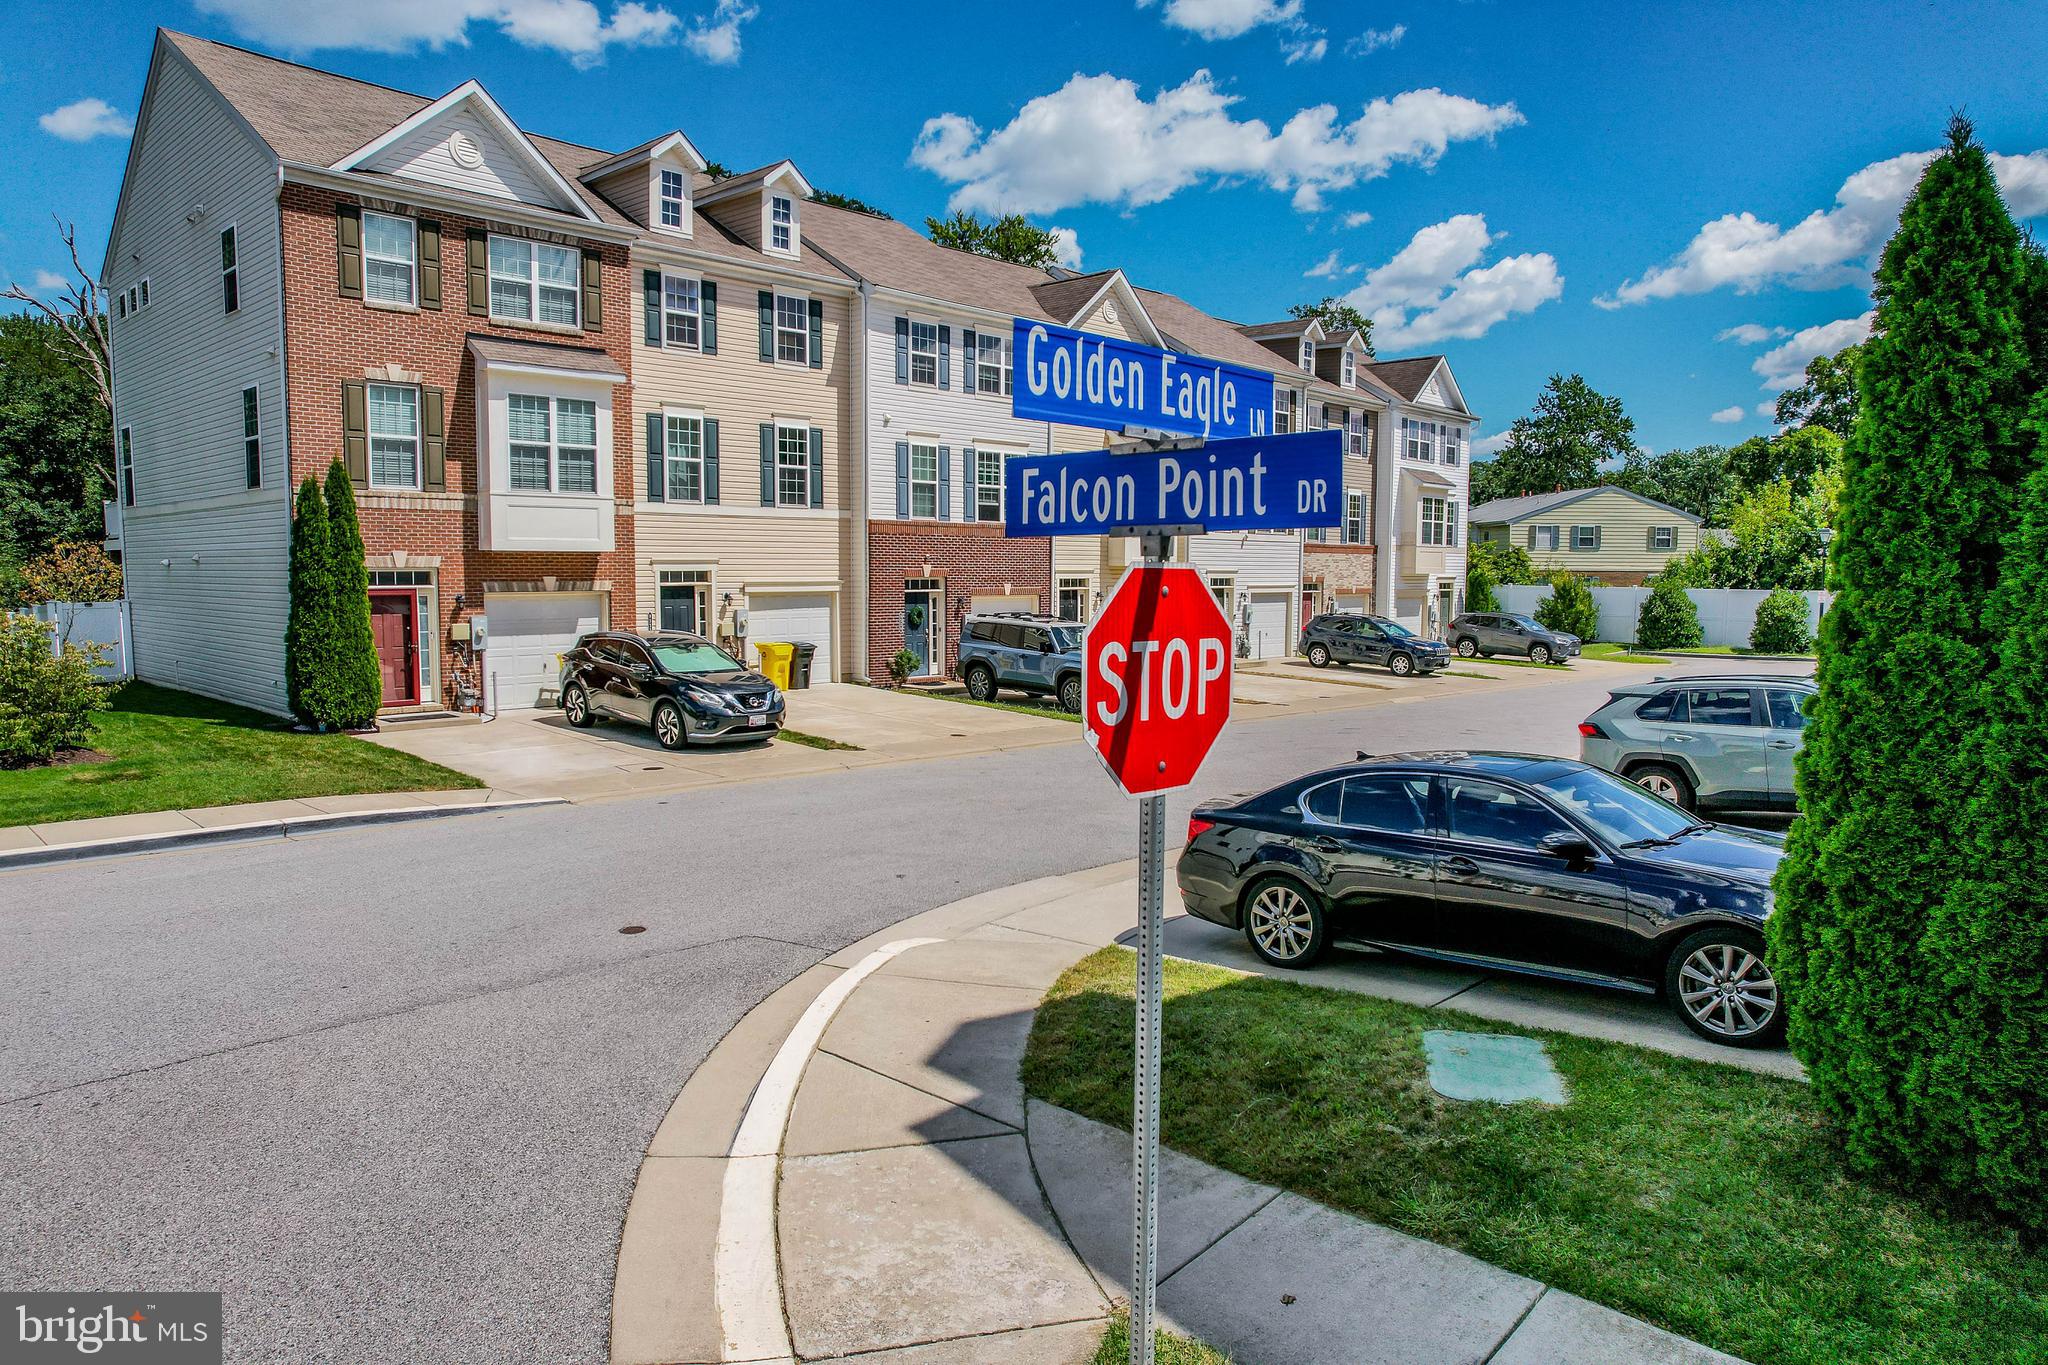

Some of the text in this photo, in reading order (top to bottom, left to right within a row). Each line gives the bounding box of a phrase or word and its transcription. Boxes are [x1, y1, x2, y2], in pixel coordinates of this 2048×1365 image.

[1027, 325, 1265, 439] Golden Eagle LN
[1022, 451, 1327, 525] Falcon Point DR
[1096, 637, 1225, 727] STOP
